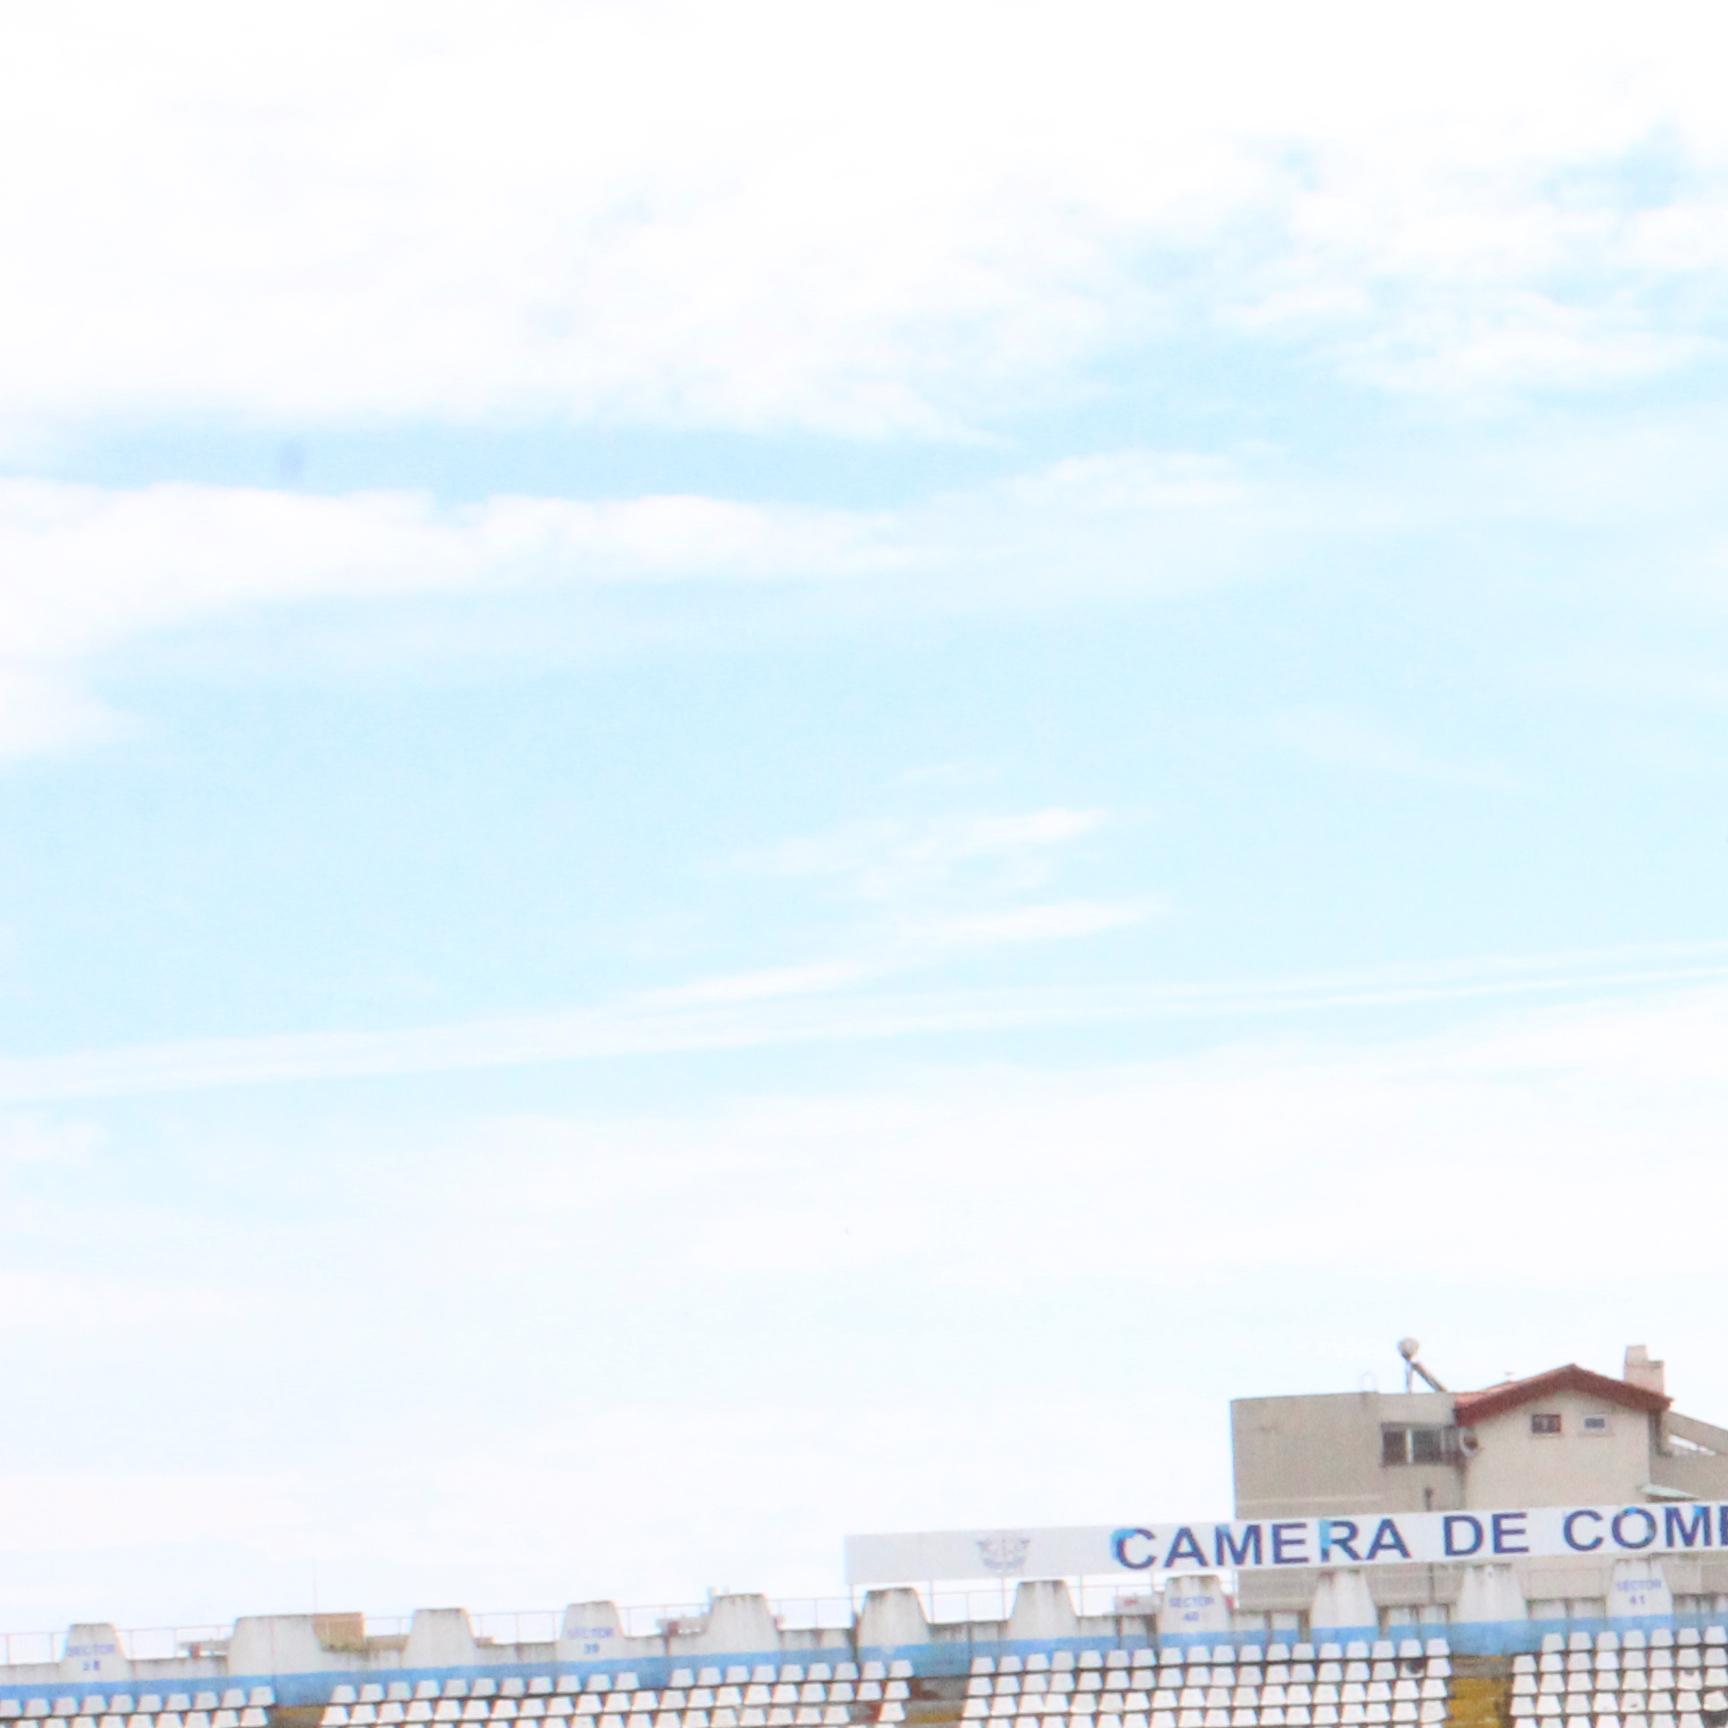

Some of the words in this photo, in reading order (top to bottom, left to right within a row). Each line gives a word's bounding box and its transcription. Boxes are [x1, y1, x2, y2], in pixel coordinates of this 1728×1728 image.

[1114, 1518, 1412, 1569] CAMERA
[1444, 1511, 1530, 1557] DE
[1616, 1579, 1662, 1592] SECTOR
[1169, 1596, 1215, 1608] SECTOR
